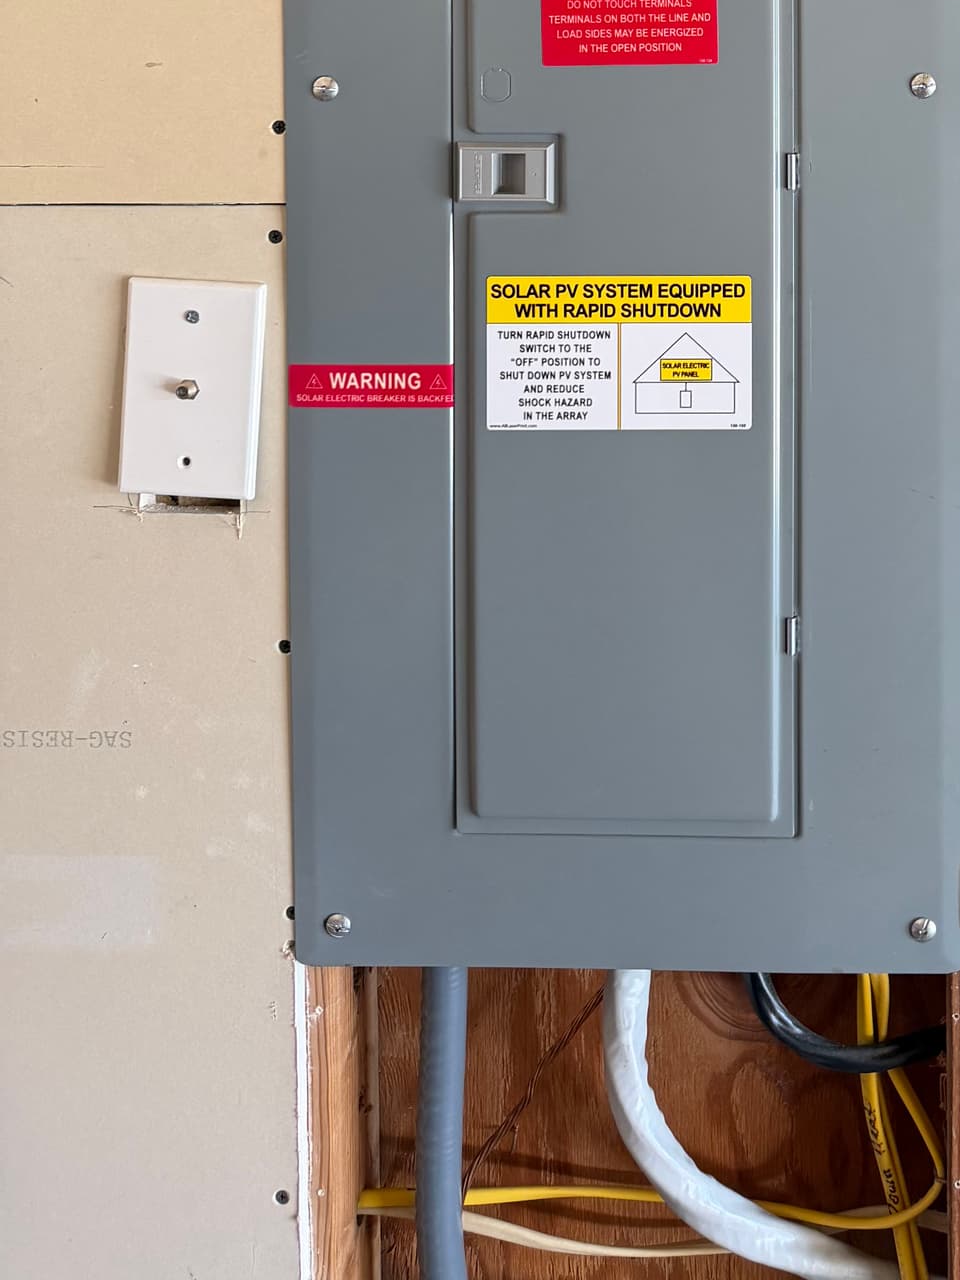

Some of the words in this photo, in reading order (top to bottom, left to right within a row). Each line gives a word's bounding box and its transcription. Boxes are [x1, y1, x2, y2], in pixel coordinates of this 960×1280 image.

[567, 0, 581, 9] DO
[583, 0, 602, 9] NOT
[605, 0, 637, 9] TOUCH
[549, 14, 602, 25] TERMINALS
[603, 14, 618, 24] ON
[620, 14, 646, 23] BOTH
[648, 13, 666, 23] THE
[668, 13, 689, 22] LINE
[690, 12, 711, 22] AND
[556, 29, 583, 39] LOAD
[584, 29, 612, 39] SIDES
[614, 28, 633, 38] MAY
[635, 28, 648, 38] BE
[651, 27, 704, 38] ENERGIZED
[578, 44, 588, 53] IN
[590, 43, 608, 53] THE
[610, 43, 637, 53] OPEN
[639, 42, 682, 52] POSITION
[491, 283, 551, 299] SOLAR
[555, 283, 578, 299] PV
[583, 283, 652, 299] SYSTEM
[658, 283, 745, 299] EQUIPPED
[514, 303, 559, 318] WITH
[563, 303, 616, 318] RAPID
[620, 303, 721, 318] SHUTDOWN
[498, 331, 523, 340] TURN
[525, 331, 554, 340] RAPID
[557, 331, 611, 340] SHUTDOWN
[519, 344, 556, 353] SWITCH
[558, 344, 571, 353] TO
[573, 344, 592, 353] THE
[541, 357, 587, 366] POSITION
[589, 357, 601, 366] TO
[499, 371, 525, 380] SHUT
[527, 371, 557, 380] DOWN
[559, 371, 572, 380] PV
[574, 371, 612, 380] SYSTEM
[329, 372, 422, 390] WARNING
[523, 384, 544, 393] AND
[546, 384, 585, 393] REDUCE
[296, 394, 324, 402] SOLAR
[325, 394, 365, 402] ELECTRIC
[366, 394, 406, 402] BREAKER
[407, 394, 416, 402] IS
[518, 398, 552, 407] SHOCK
[554, 398, 593, 407] HAZARD
[523, 412, 534, 421] IN
[536, 412, 554, 421] THE
[556, 412, 588, 421] ARRAY
[0, 730, 132, 749] SAG-RESIS
